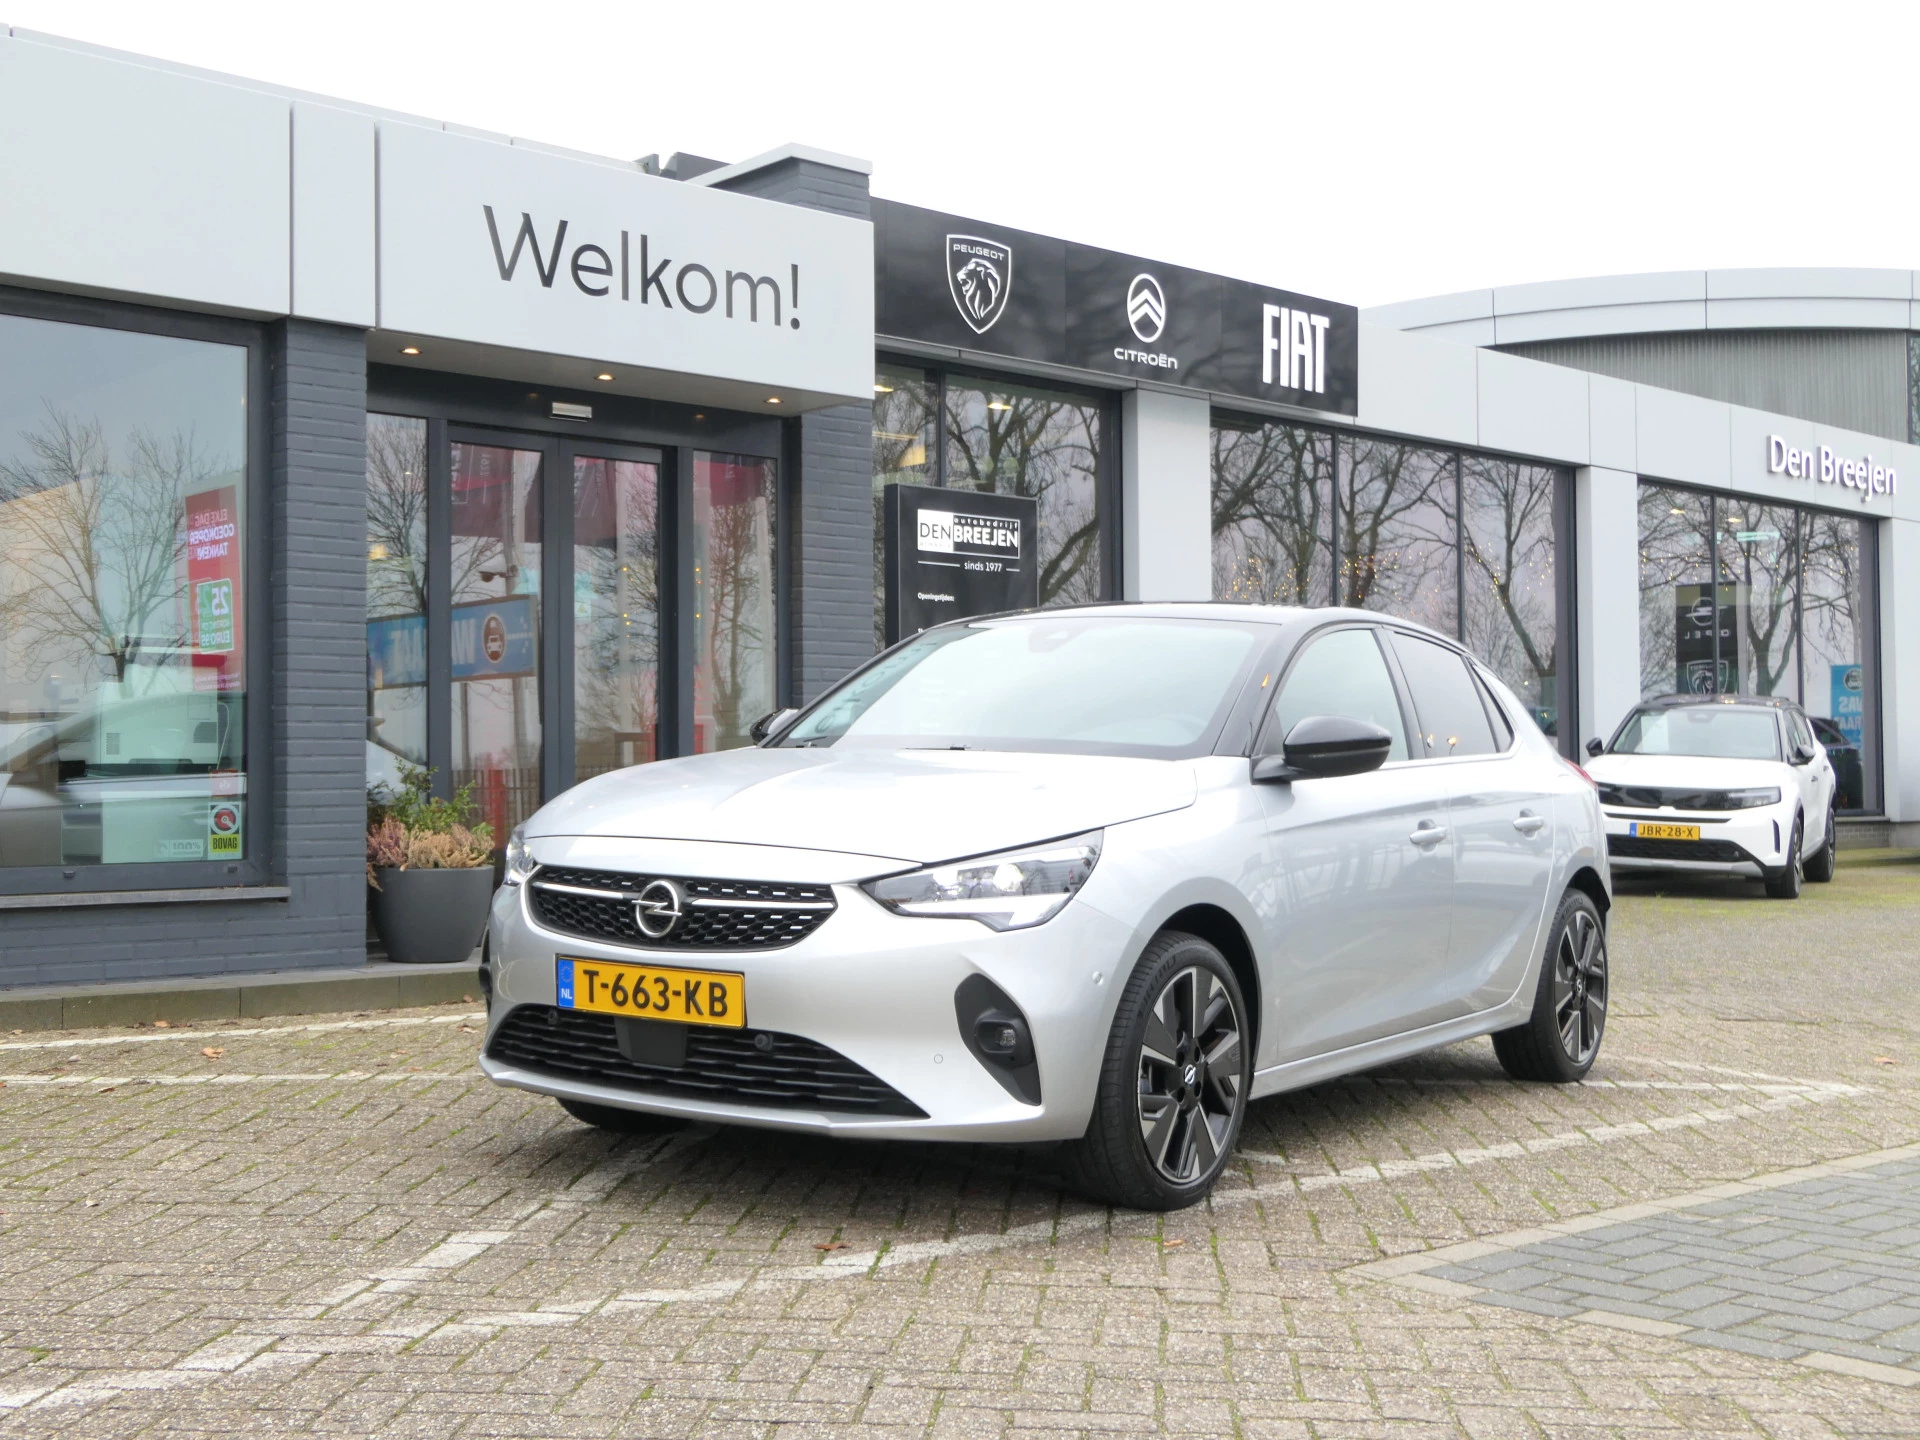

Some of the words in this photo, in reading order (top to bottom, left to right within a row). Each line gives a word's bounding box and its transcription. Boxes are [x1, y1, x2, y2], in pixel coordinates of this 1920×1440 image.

[953, 243, 1005, 261] PEUGEOT
[482, 204, 801, 330] Welkom!
[1113, 347, 1178, 370] CITROËN
[1262, 303, 1330, 394] FIAT
[1766, 434, 1814, 480] Den
[1816, 444, 1897, 504] Breejen
[919, 522, 952, 541] DEN
[953, 525, 1019, 548] BREEJEN
[953, 517, 1018, 530] autobedrijf
[964, 561, 984, 571] sinds
[985, 562, 1003, 572] 1977
[1640, 825, 1694, 838] JBR-28-X
[212, 837, 238, 850] BOVAG
[561, 988, 573, 1000] NL
[582, 968, 728, 1017] T-663-KB
